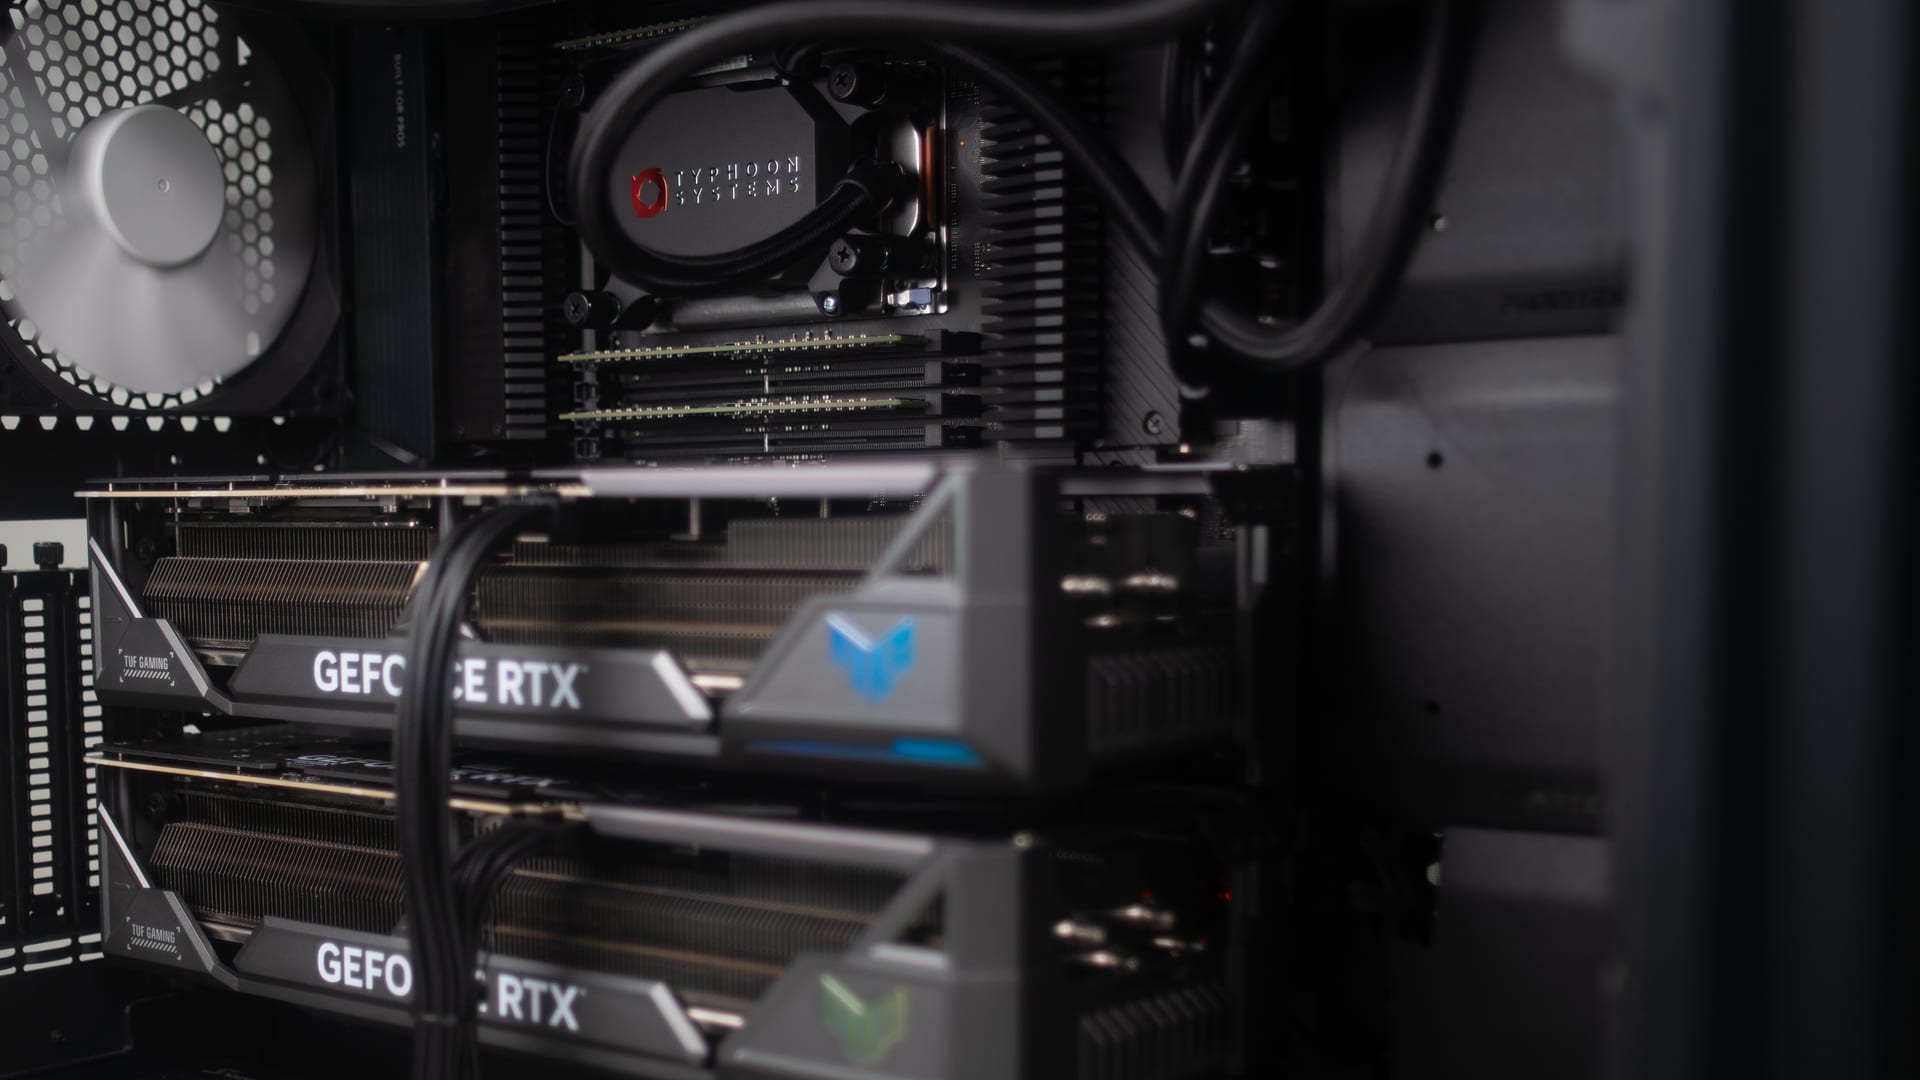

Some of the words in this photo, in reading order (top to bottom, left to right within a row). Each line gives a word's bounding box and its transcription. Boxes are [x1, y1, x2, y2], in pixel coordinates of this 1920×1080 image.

[675, 155, 801, 188] TYPHOON
[675, 177, 801, 206] SYSTEMS
[124, 655, 138, 668] TUF
[139, 657, 169, 670] GAMING
[313, 650, 489, 702] GEFOE
[497, 659, 581, 710] RTX
[131, 923, 145, 937] TUF
[146, 926, 176, 944] GAMING
[497, 973, 580, 1032] RTX
